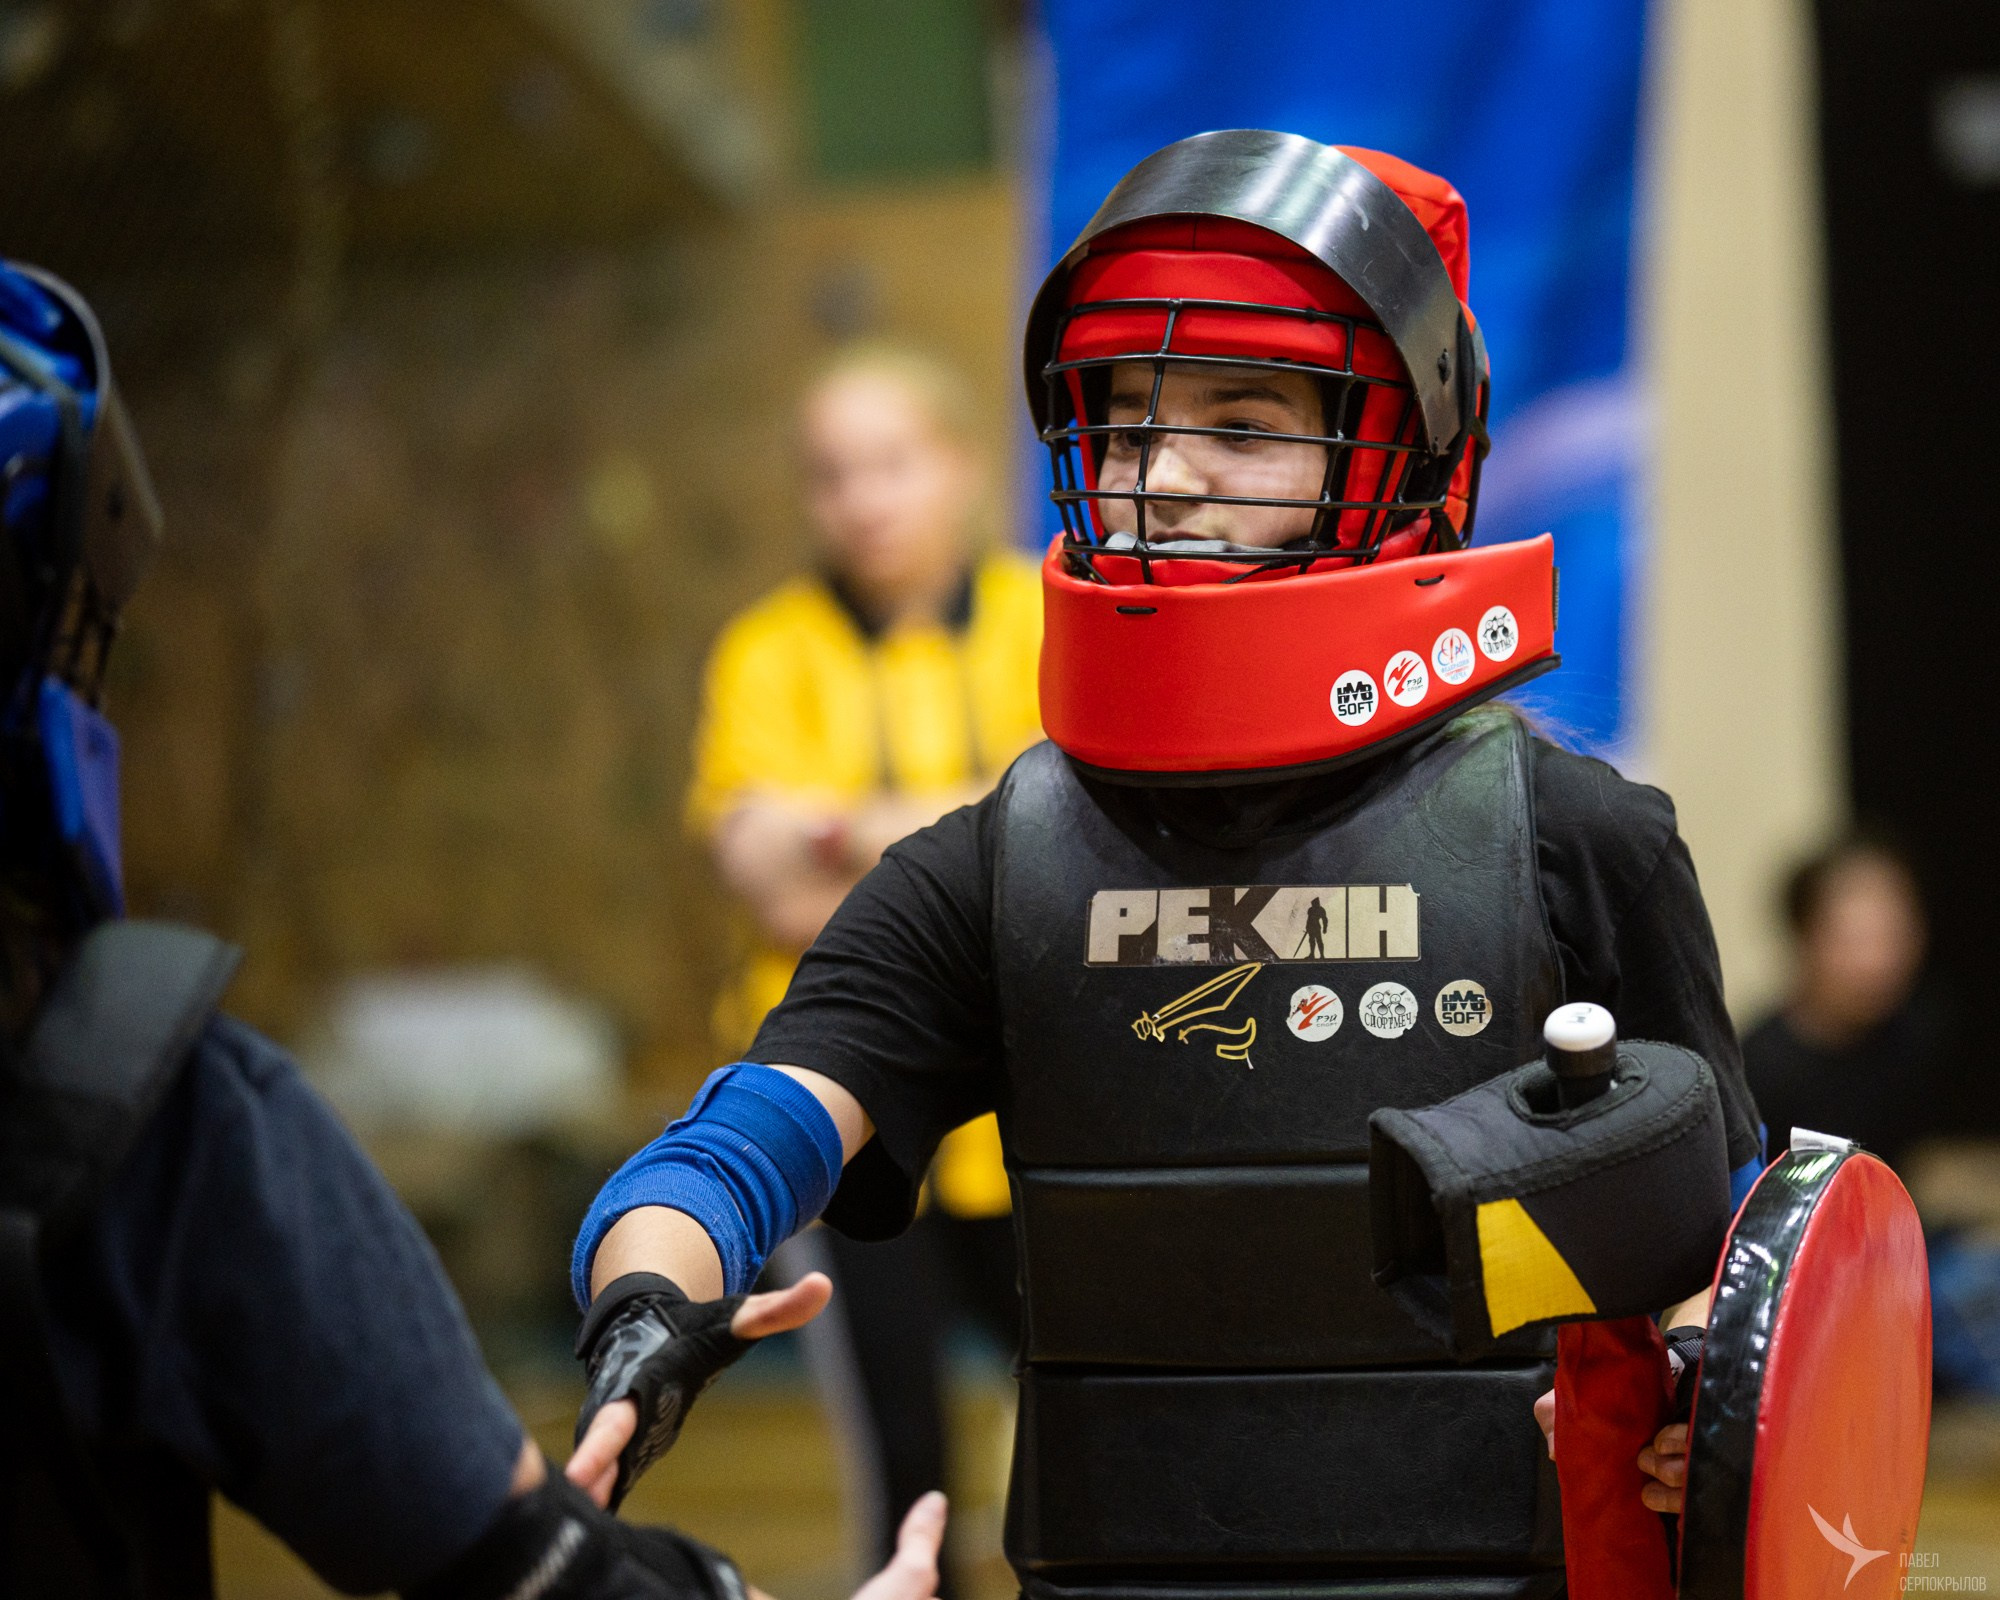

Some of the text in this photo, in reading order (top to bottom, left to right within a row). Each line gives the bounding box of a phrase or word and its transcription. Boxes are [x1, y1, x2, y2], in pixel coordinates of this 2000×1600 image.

[1338, 701, 1373, 716] SOFT
[1364, 1011, 1412, 1029] СПОРТМЕЧ
[1442, 1011, 1486, 1024] SOFT
